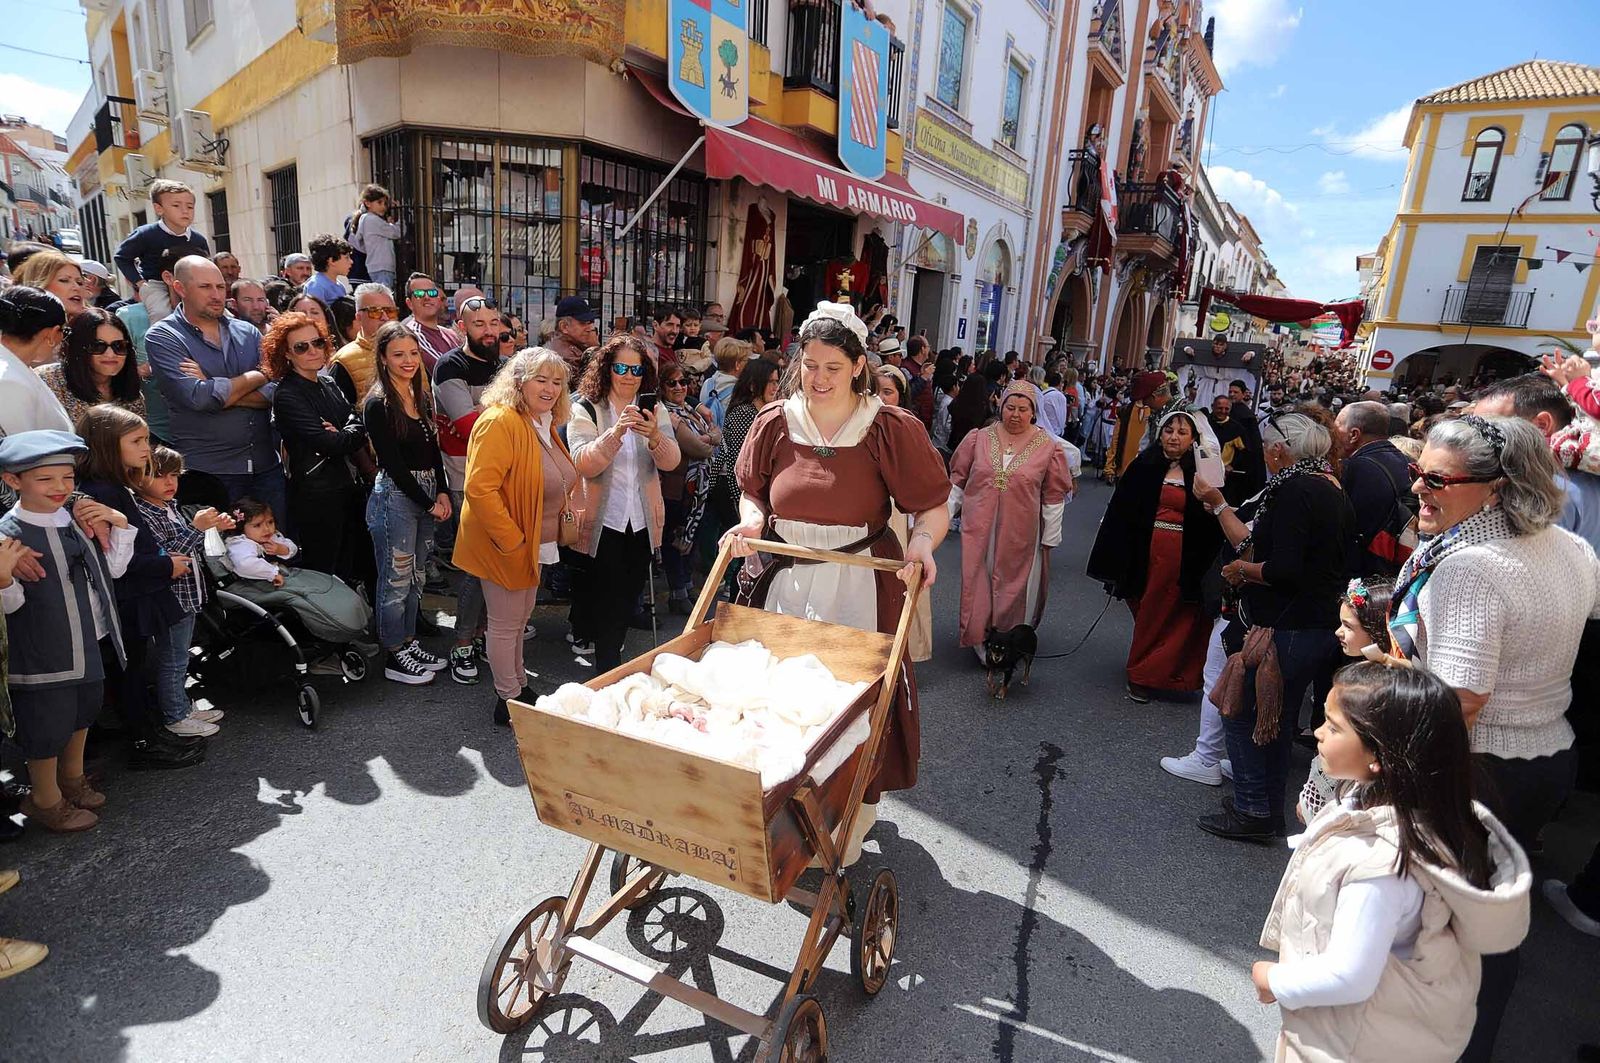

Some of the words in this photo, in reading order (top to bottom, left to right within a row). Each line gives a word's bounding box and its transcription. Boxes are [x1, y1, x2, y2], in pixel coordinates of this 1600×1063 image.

[920, 126, 947, 153] Oficina
[816, 173, 838, 202] MI
[847, 184, 917, 222] ARMARIO
[566, 801, 738, 871] ALMADRABA
